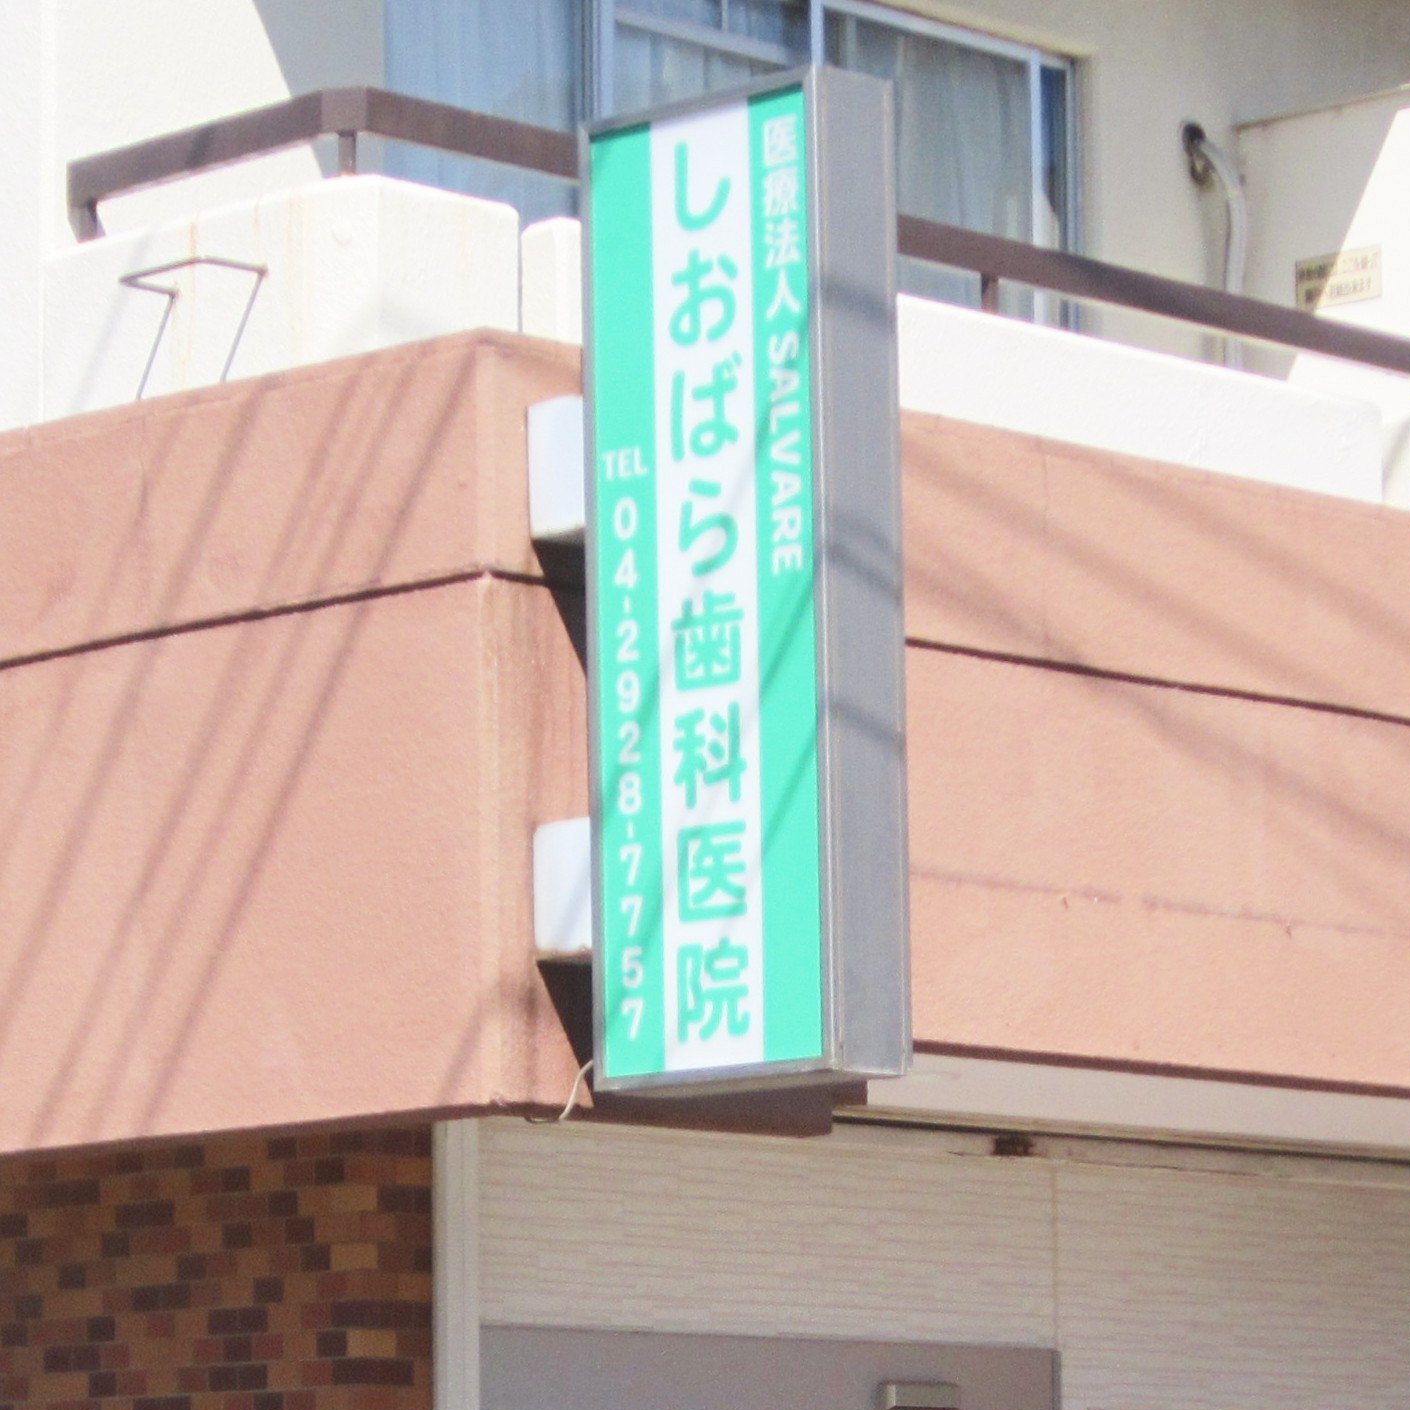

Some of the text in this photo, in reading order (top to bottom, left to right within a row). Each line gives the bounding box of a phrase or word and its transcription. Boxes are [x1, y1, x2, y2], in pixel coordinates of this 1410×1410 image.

[669, 141, 750, 1044] しおばら歯科医院
[762, 113, 802, 576] 医療法人 SALVARE
[602, 447, 648, 1041] TEL 04-2928-7757
